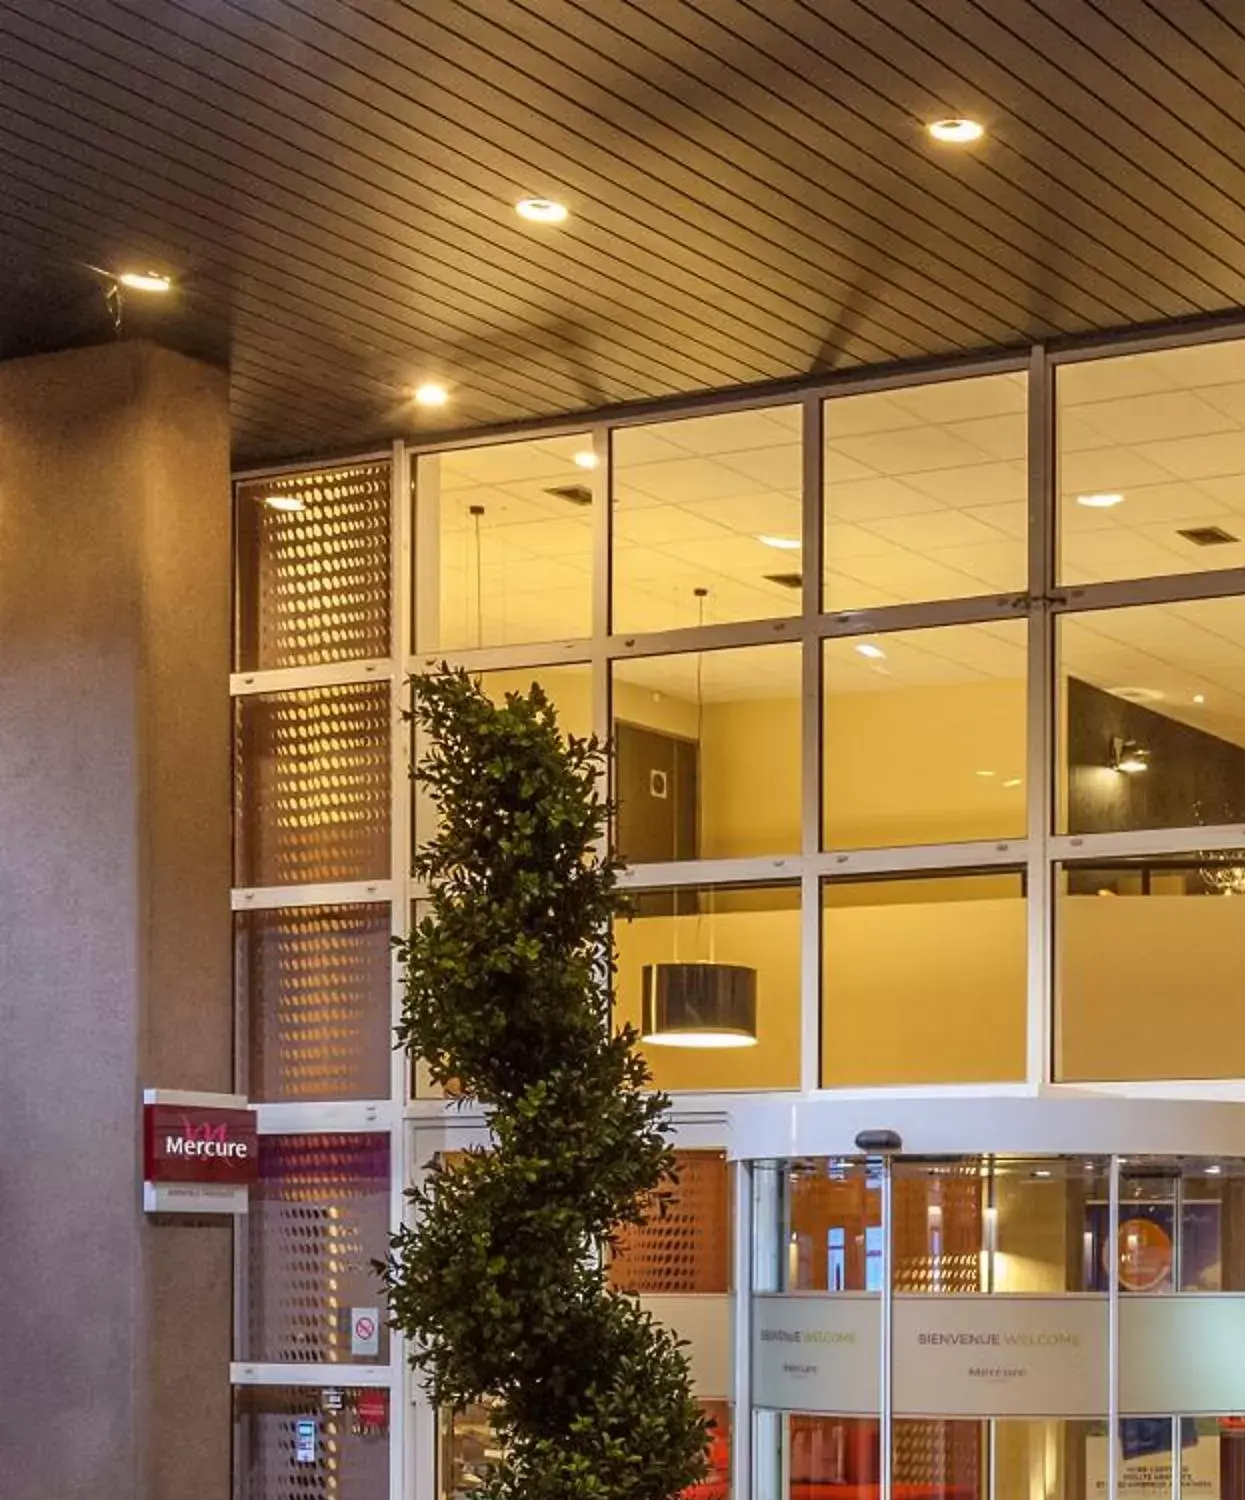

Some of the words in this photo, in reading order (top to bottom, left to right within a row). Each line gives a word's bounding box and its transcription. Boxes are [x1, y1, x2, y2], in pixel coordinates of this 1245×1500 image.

[166, 1136, 248, 1158] Mercure
[918, 1333, 1000, 1345] BIENVENUE
[1004, 1333, 1081, 1346] WELCOME
